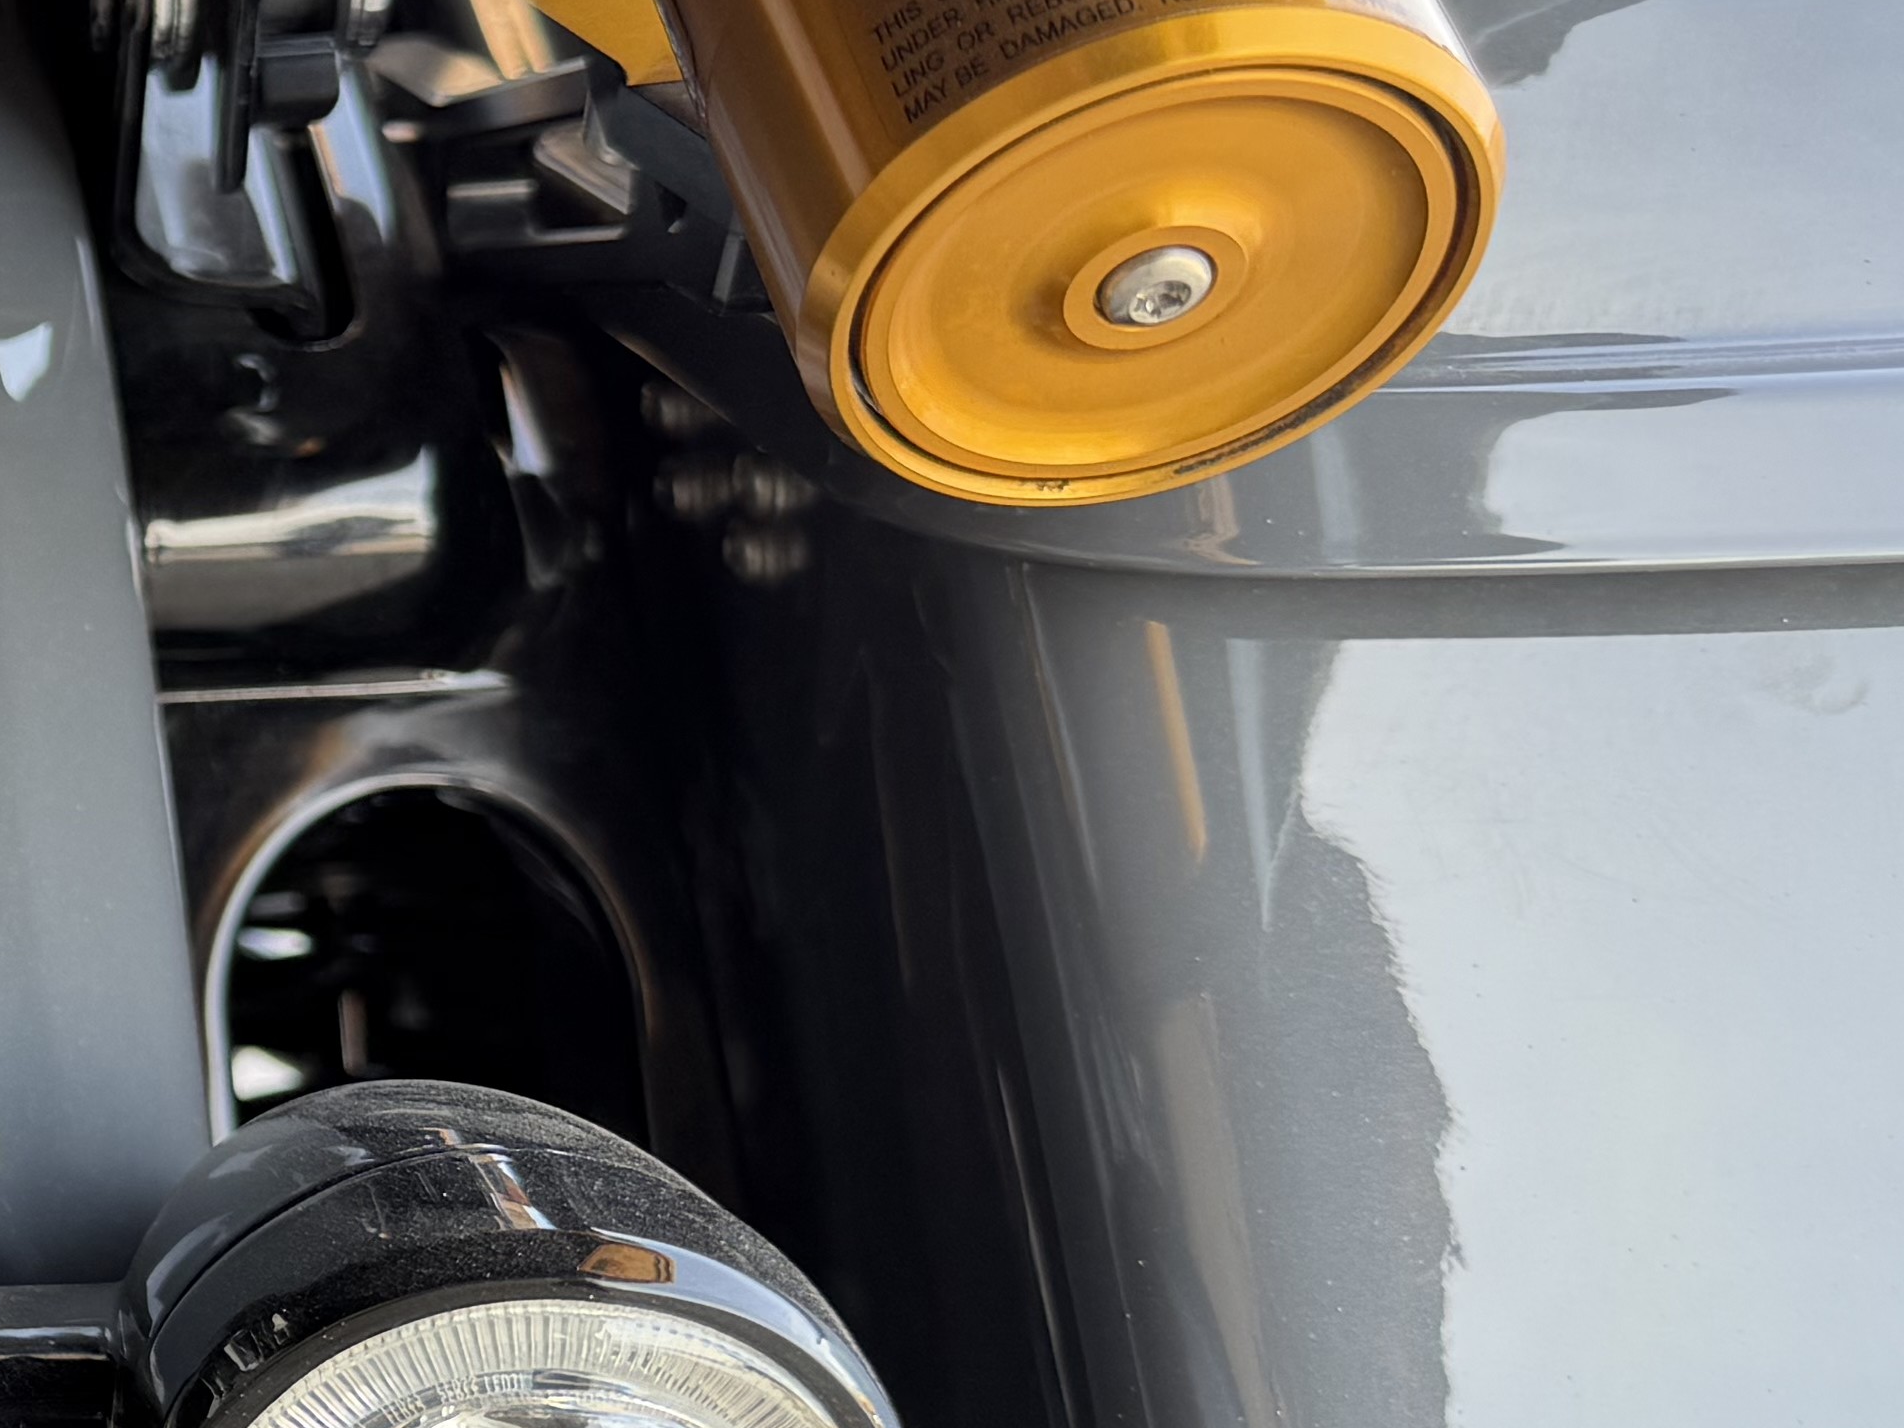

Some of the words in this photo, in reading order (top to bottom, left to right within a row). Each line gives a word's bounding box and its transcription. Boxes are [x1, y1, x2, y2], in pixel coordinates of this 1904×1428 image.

[872, 0, 922, 45] THIS
[880, 6, 962, 72] UNDER
[891, 48, 944, 99] LING
[957, 21, 996, 53] OR
[903, 76, 949, 124] MAY
[954, 55, 992, 88] BE
